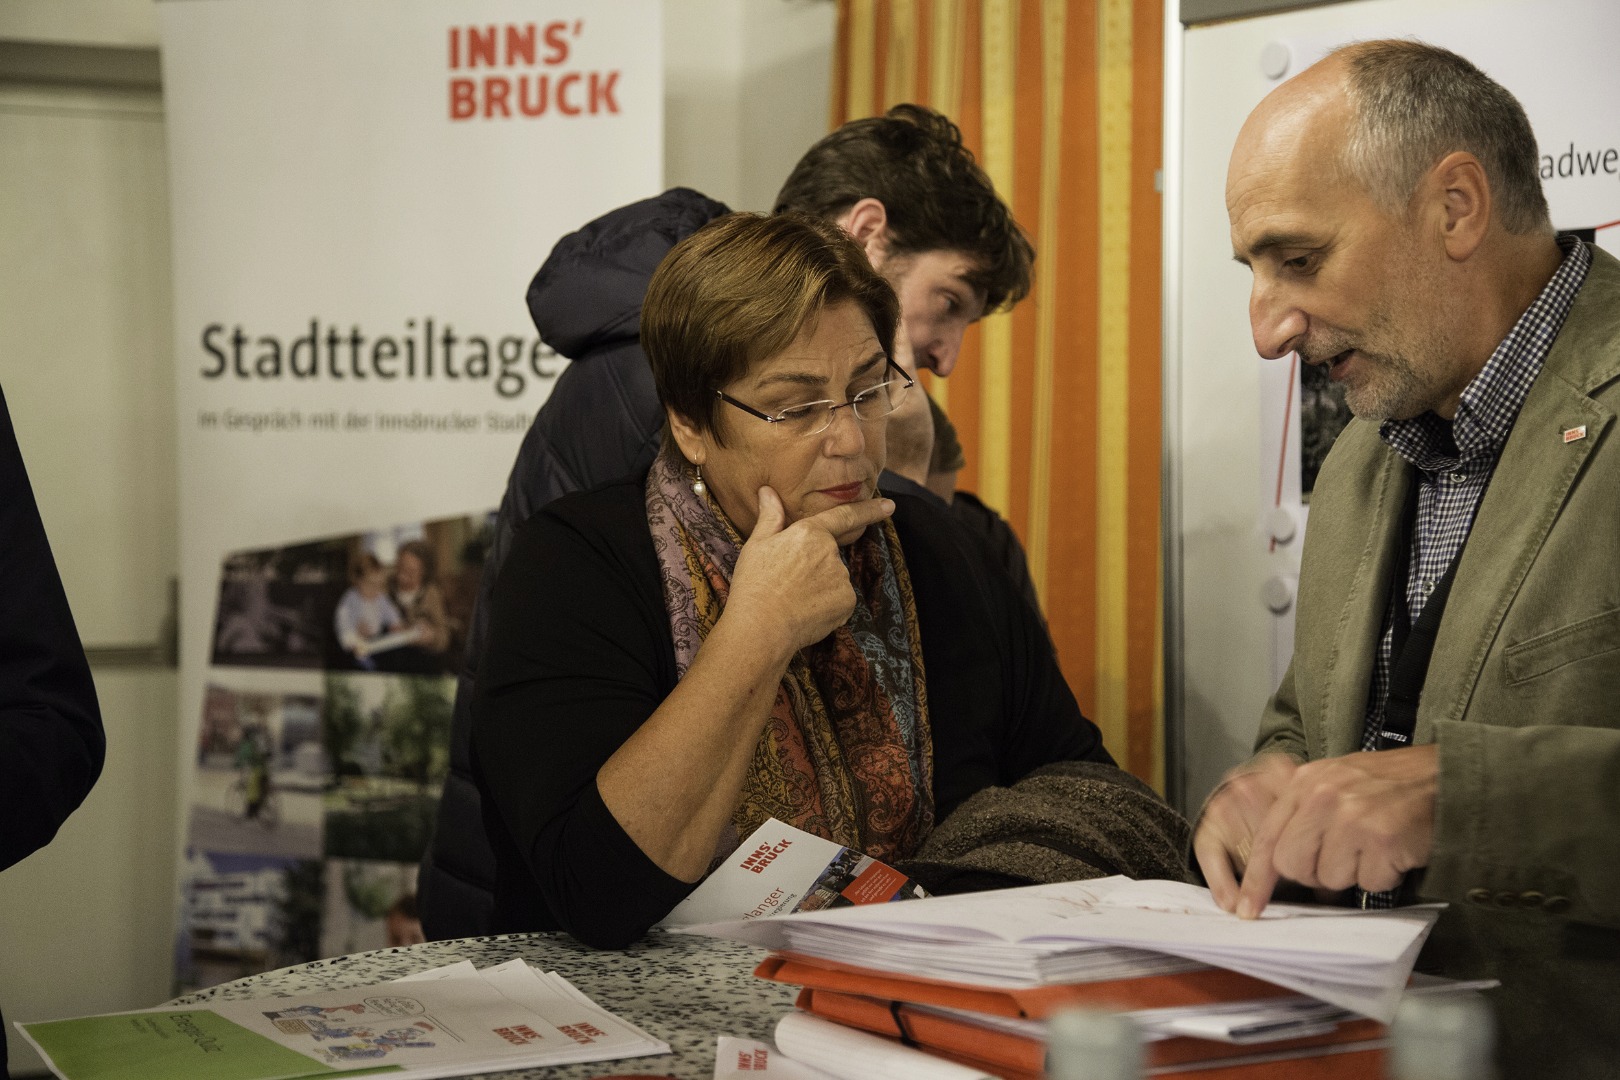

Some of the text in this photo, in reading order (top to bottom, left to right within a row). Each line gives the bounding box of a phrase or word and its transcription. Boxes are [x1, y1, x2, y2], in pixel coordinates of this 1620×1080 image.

[448, 20, 584, 70] INNS'
[448, 71, 621, 121] BRUCK
[1540, 141, 1620, 180] adwe
[200, 317, 558, 400] Stadtteiltage
[309, 410, 337, 431] mit
[345, 409, 370, 431] der
[750, 838, 793, 874] BRUCK
